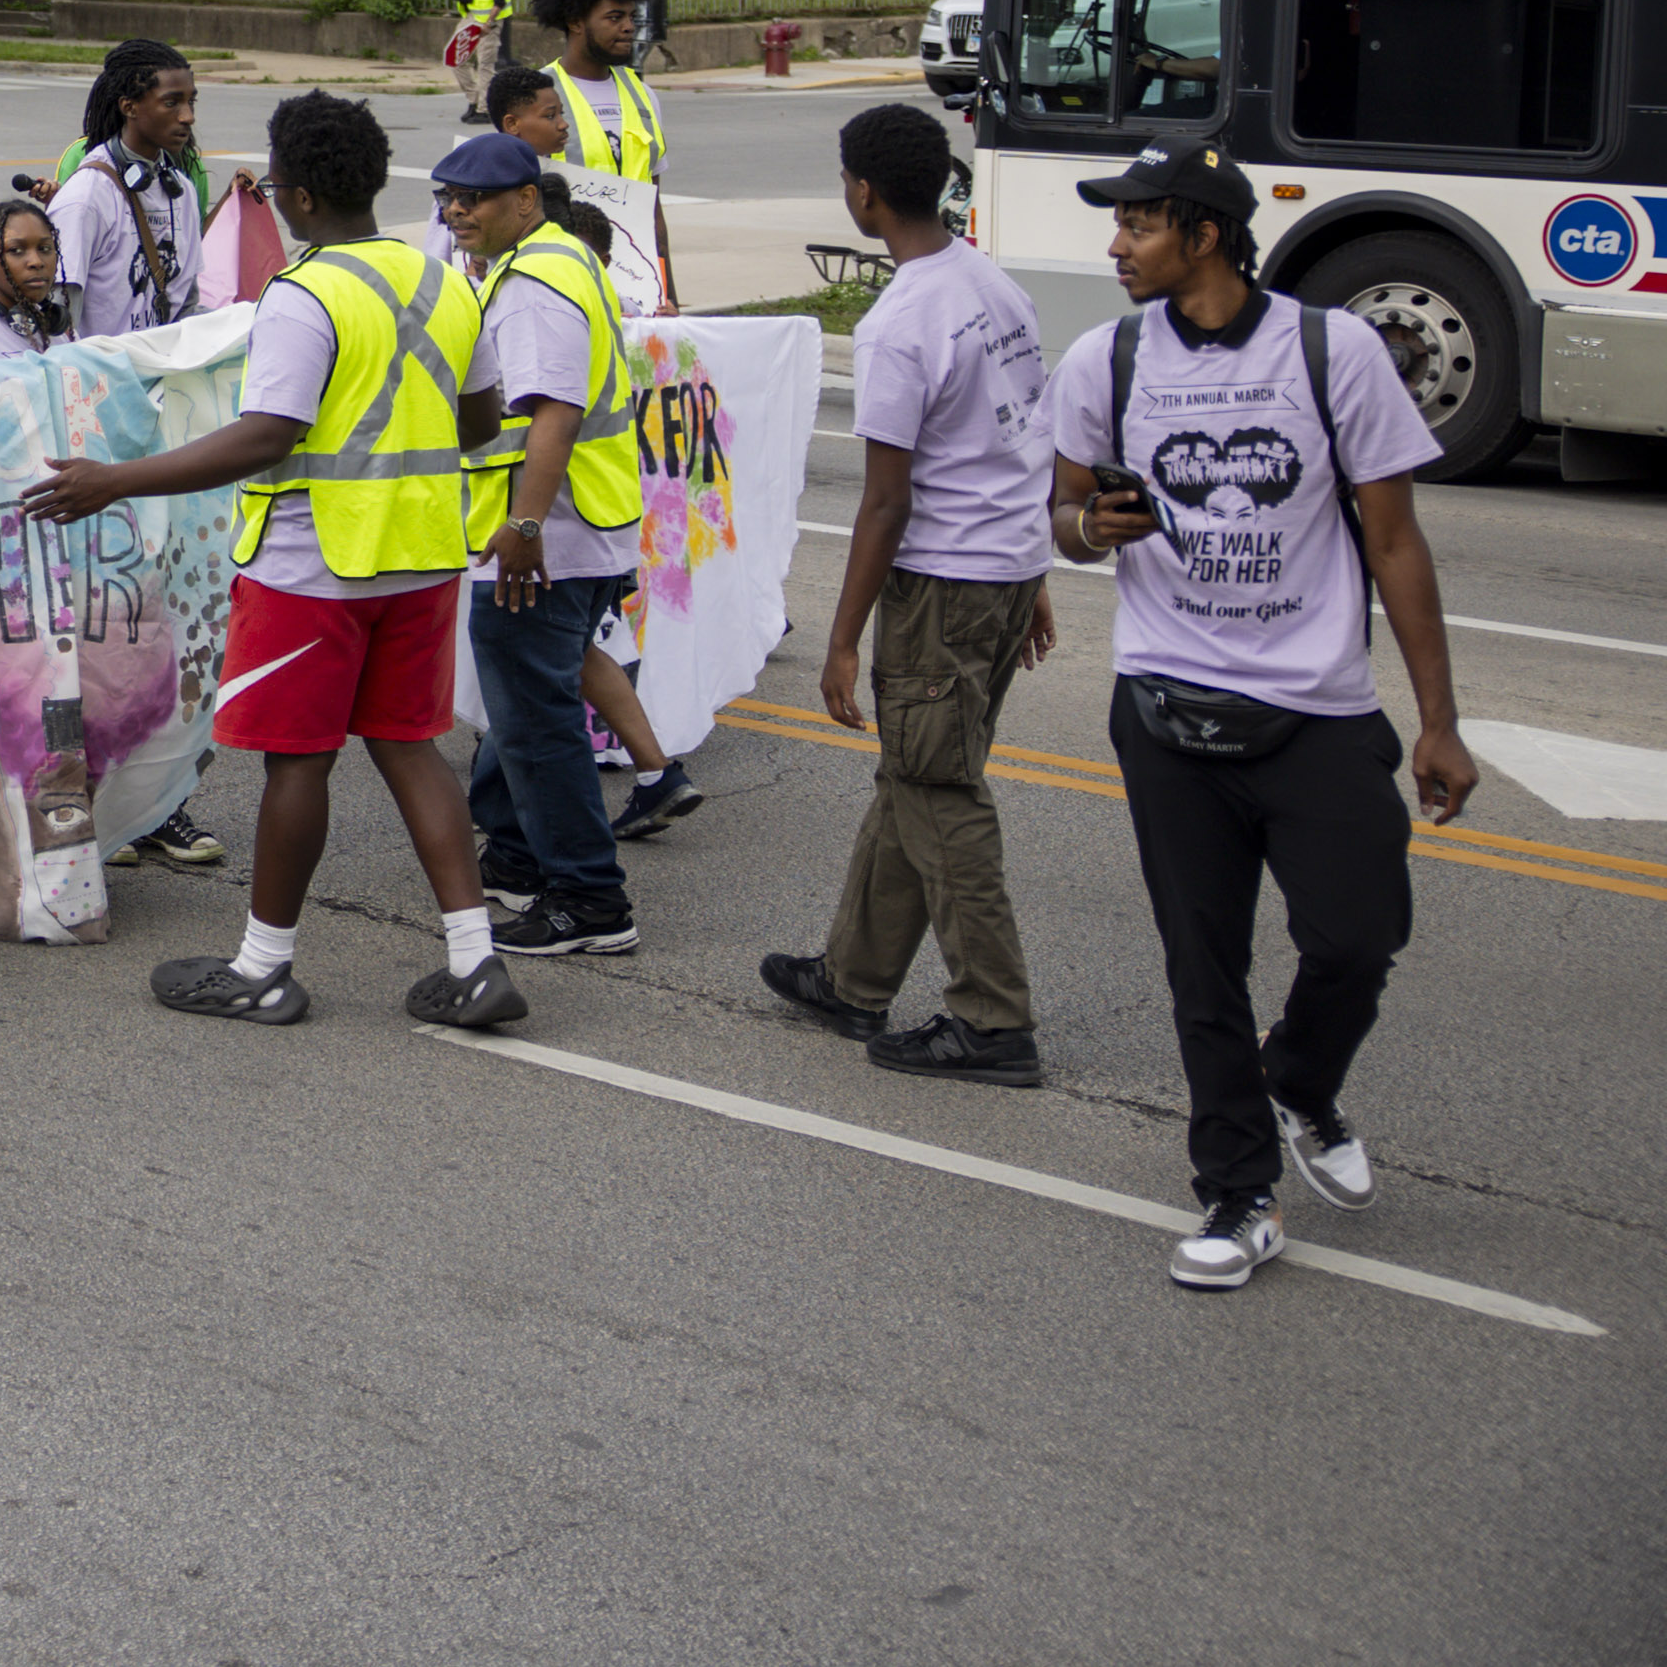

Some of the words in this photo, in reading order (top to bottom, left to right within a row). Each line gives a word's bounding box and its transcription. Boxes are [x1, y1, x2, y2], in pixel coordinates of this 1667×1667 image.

[1559, 225, 1621, 255] cta
[1161, 394, 1182, 408] 7TH
[1185, 392, 1230, 406] ANNUAL
[1234, 389, 1276, 403] MARCH
[660, 381, 729, 484] FOR
[1182, 532, 1215, 556] WE
[1220, 532, 1283, 557] WALK
[1187, 558, 1230, 583] FOR
[1236, 558, 1282, 583] HER
[1171, 595, 1213, 618] Find
[1216, 605, 1252, 619] our
[1256, 596, 1303, 624] Girls!
[1206, 742, 1245, 753] MARTIN
